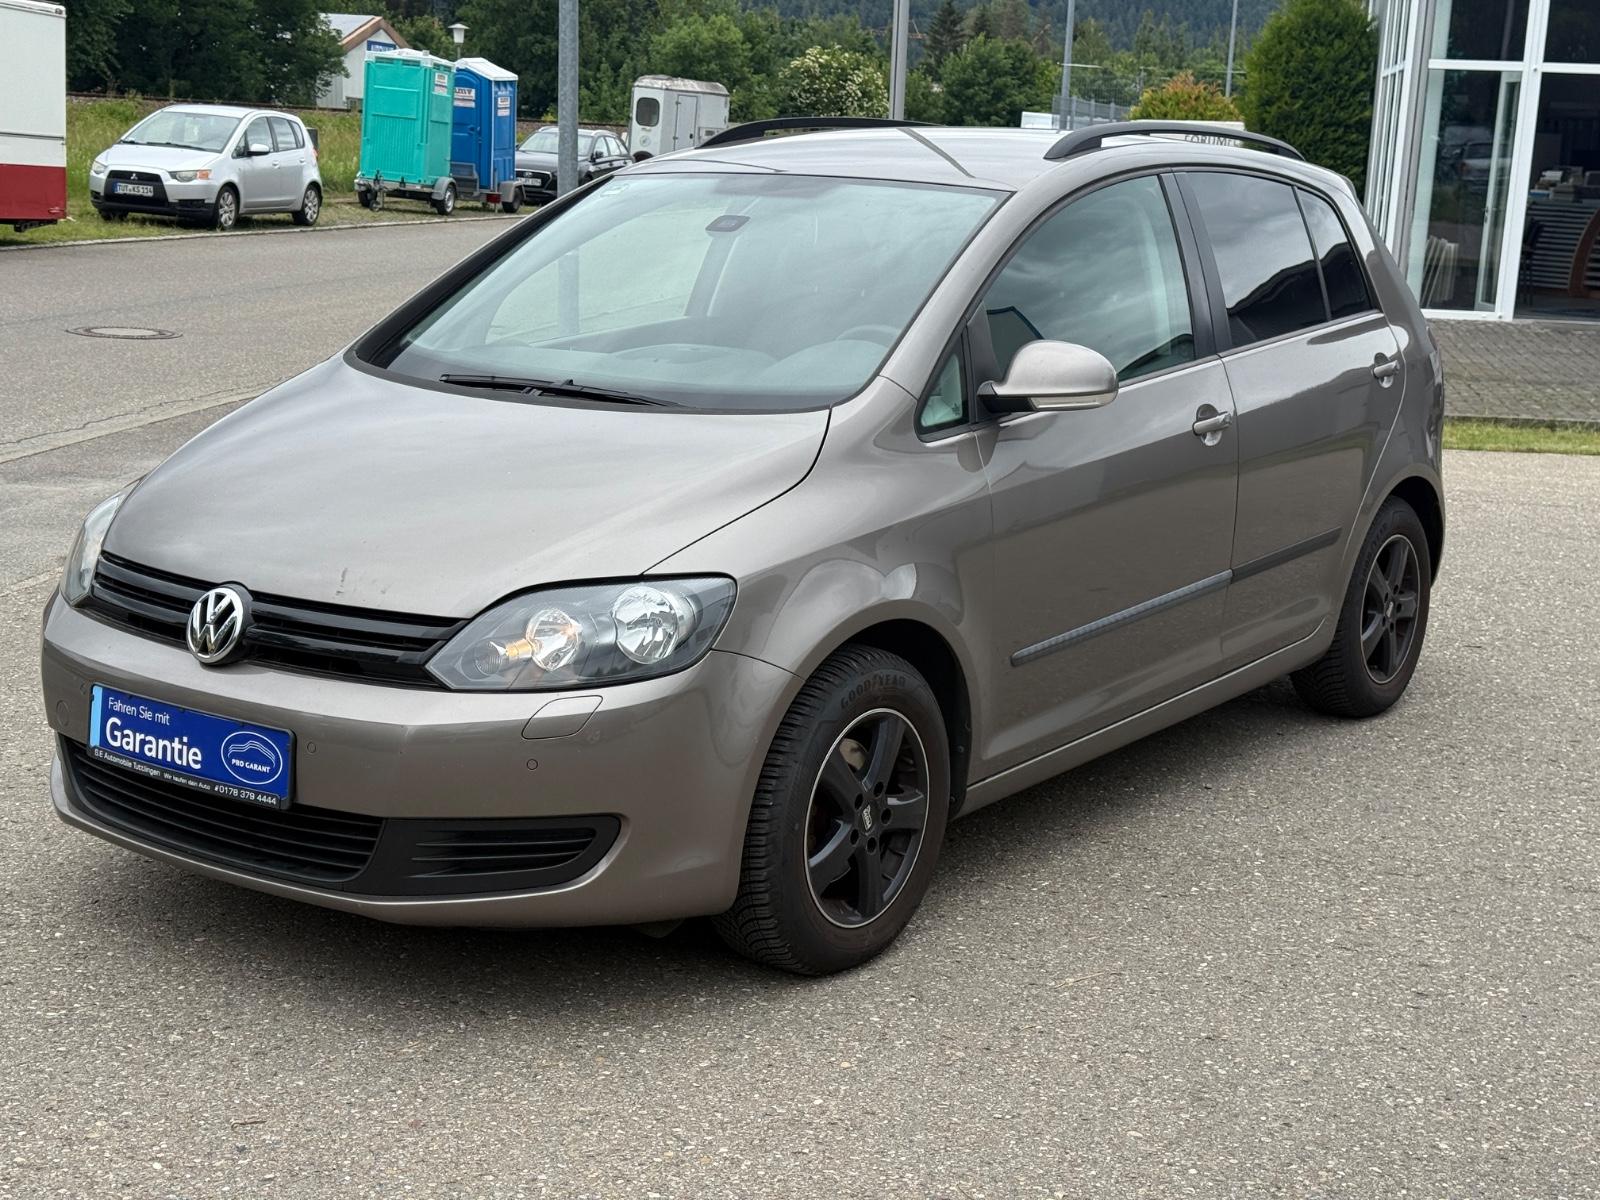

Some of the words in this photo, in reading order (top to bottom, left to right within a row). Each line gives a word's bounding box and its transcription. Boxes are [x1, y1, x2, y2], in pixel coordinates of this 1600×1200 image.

[108, 697, 137, 717] Fahren
[139, 706, 153, 721] Sie
[155, 711, 170, 726] mit
[105, 716, 202, 770] Garantie
[103, 751, 132, 768] Automobile
[132, 761, 161, 776] Tuttlingen
[256, 794, 277, 805] 4444
[231, 758, 245, 768] PRO
[245, 762, 271, 774] GARANT
